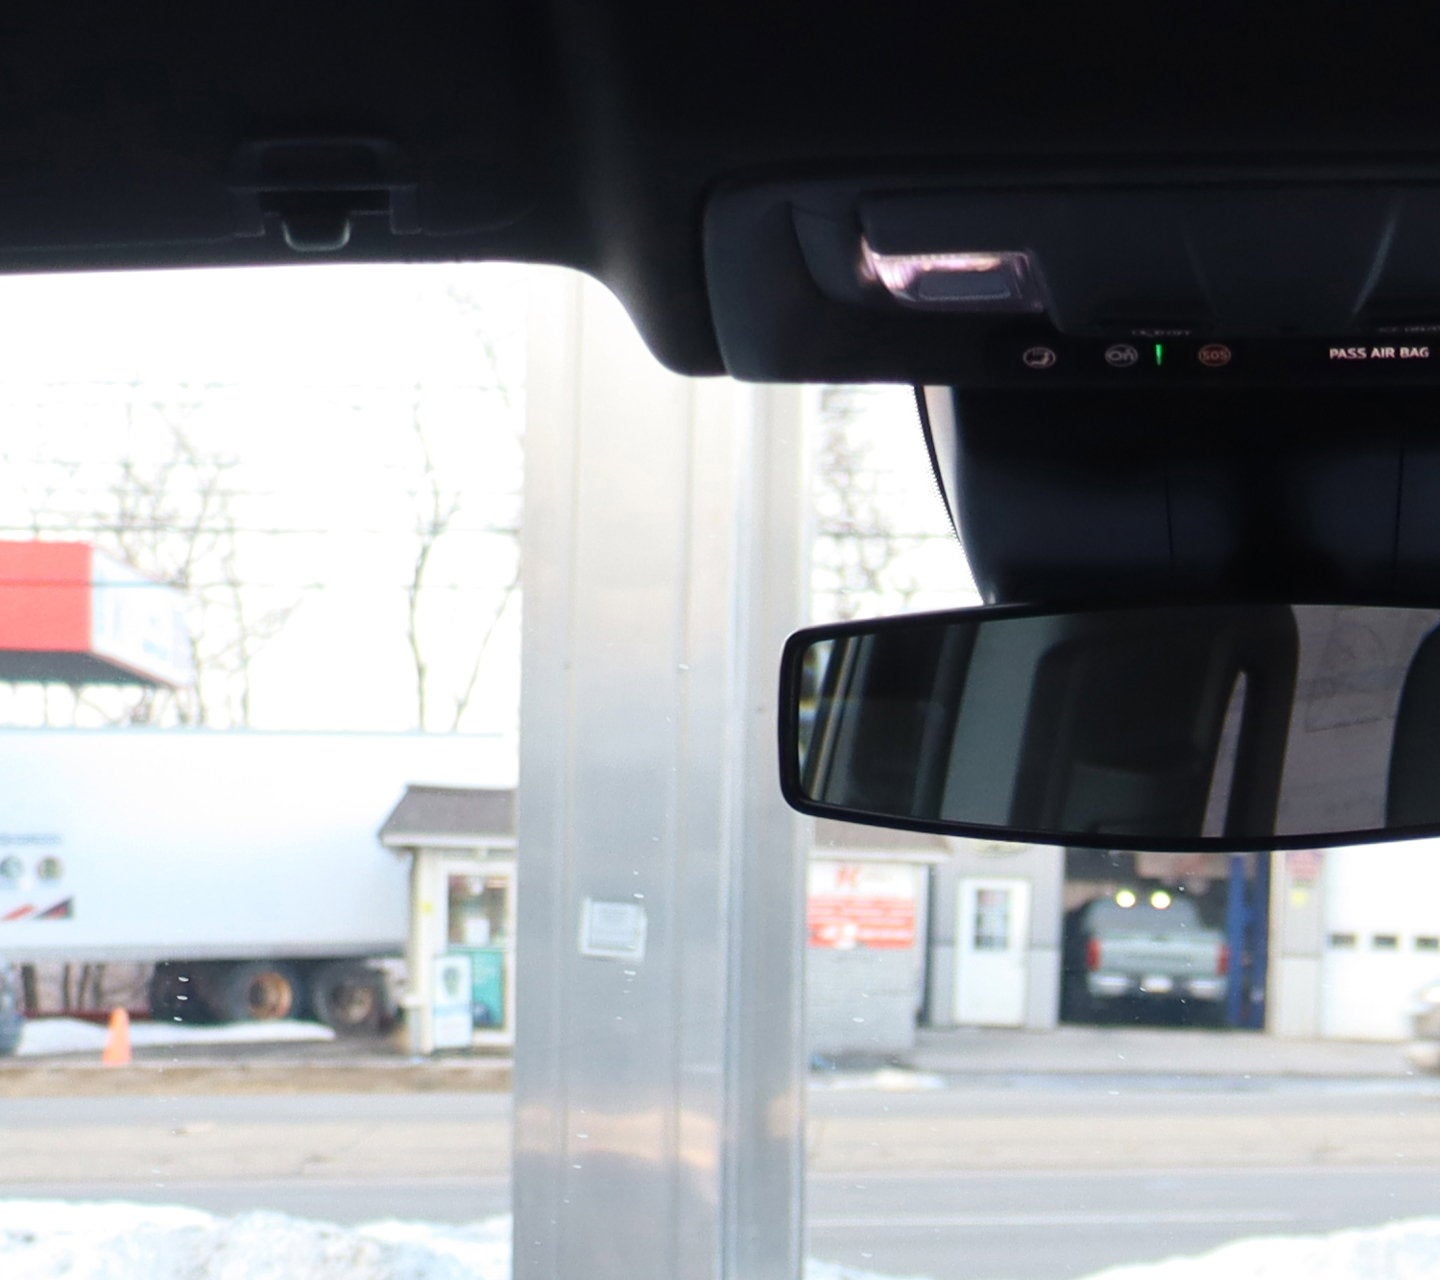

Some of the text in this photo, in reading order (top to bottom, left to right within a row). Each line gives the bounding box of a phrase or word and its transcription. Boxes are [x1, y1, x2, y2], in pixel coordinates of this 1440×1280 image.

[1328, 346, 1367, 360] PASS
[1371, 346, 1396, 359] AIR
[1399, 346, 1430, 359] BAG
